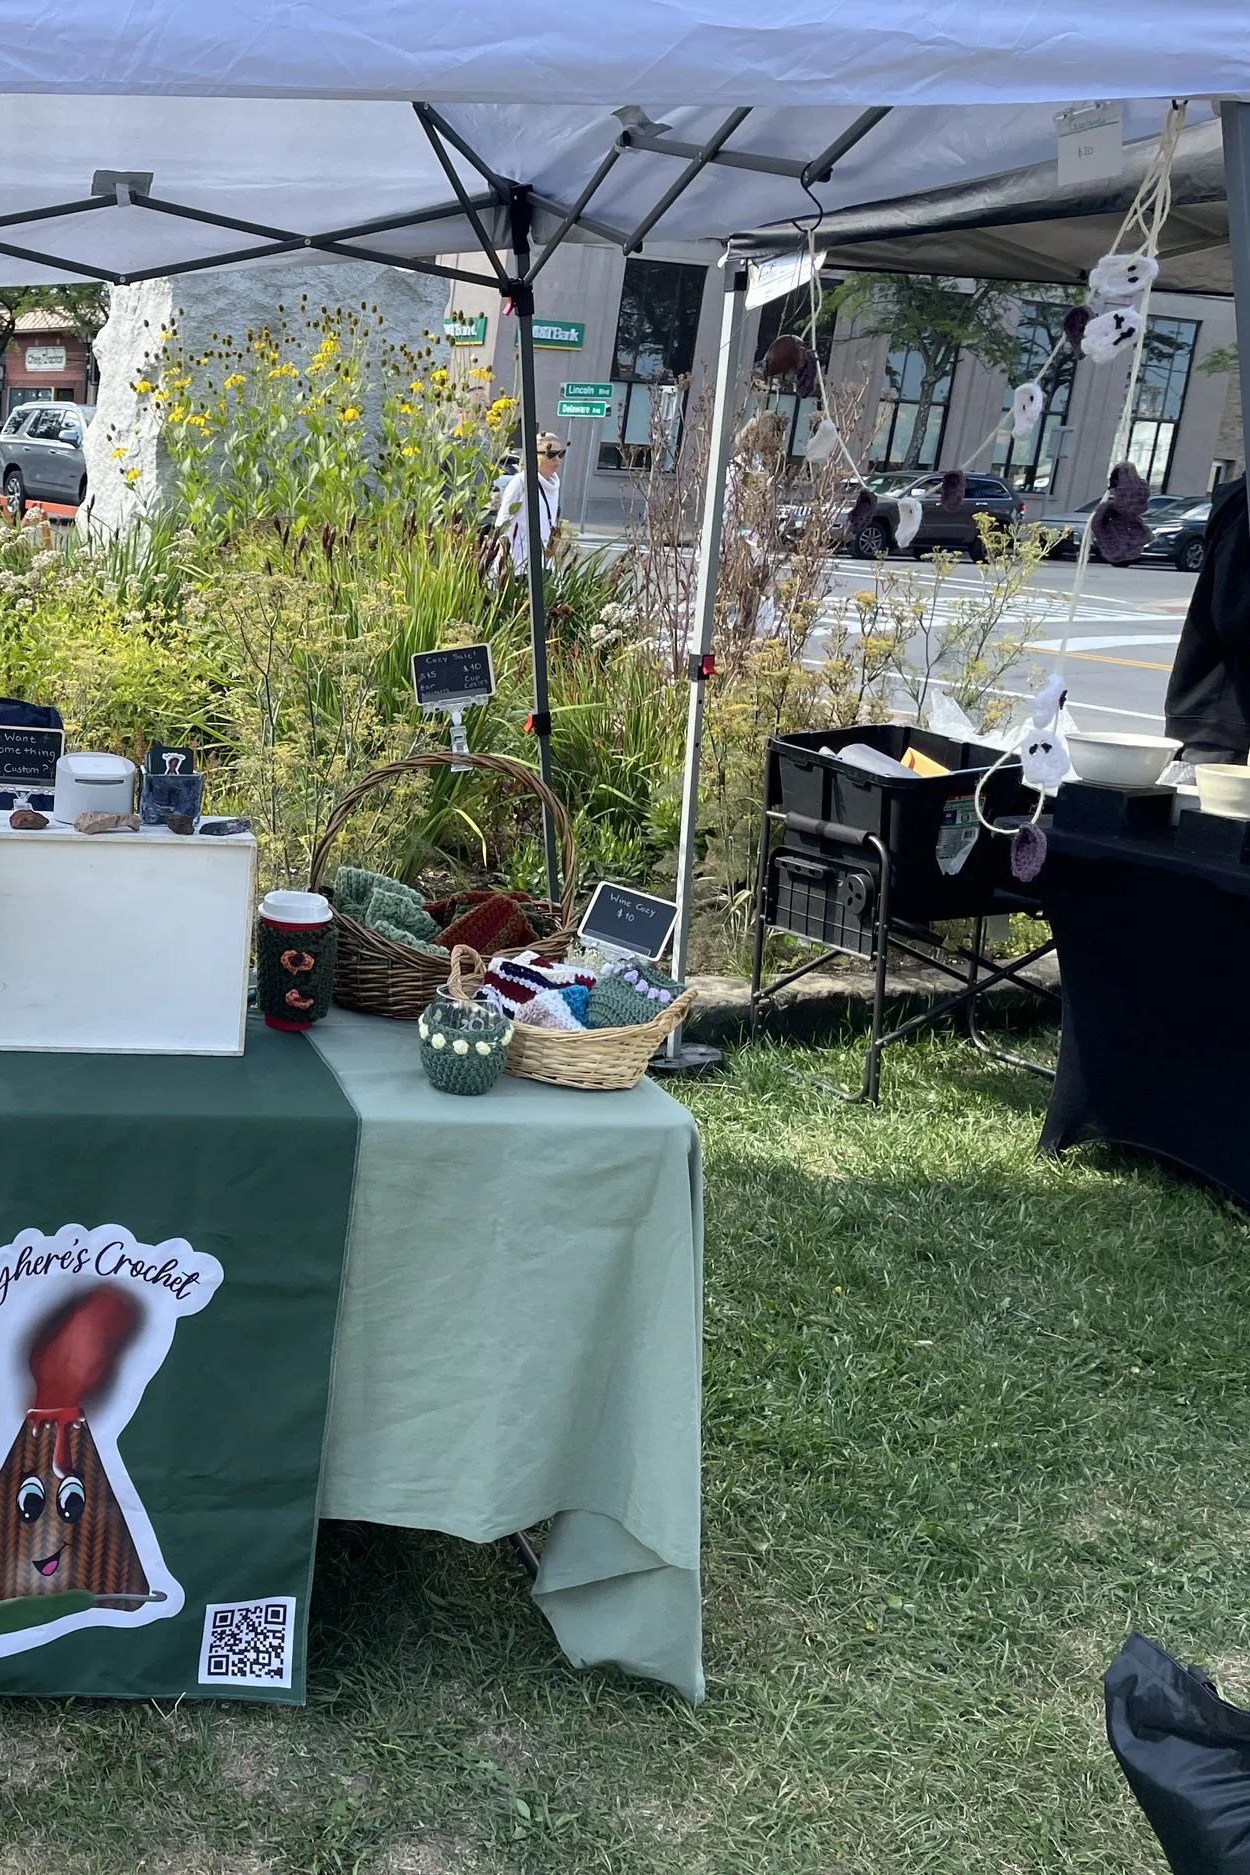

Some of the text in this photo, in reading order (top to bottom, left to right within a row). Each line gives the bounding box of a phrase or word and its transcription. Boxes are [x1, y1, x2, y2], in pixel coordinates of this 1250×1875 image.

[553, 326, 579, 342] Bank
[568, 385, 610, 395] Lincoln Blvd
[562, 403, 590, 414] Delaware
[4, 732, 37, 744] Want
[610, 893, 657, 918] Wine Cozy
[616, 908, 635, 922] $10
[94, 1240, 201, 1300] Crochet
